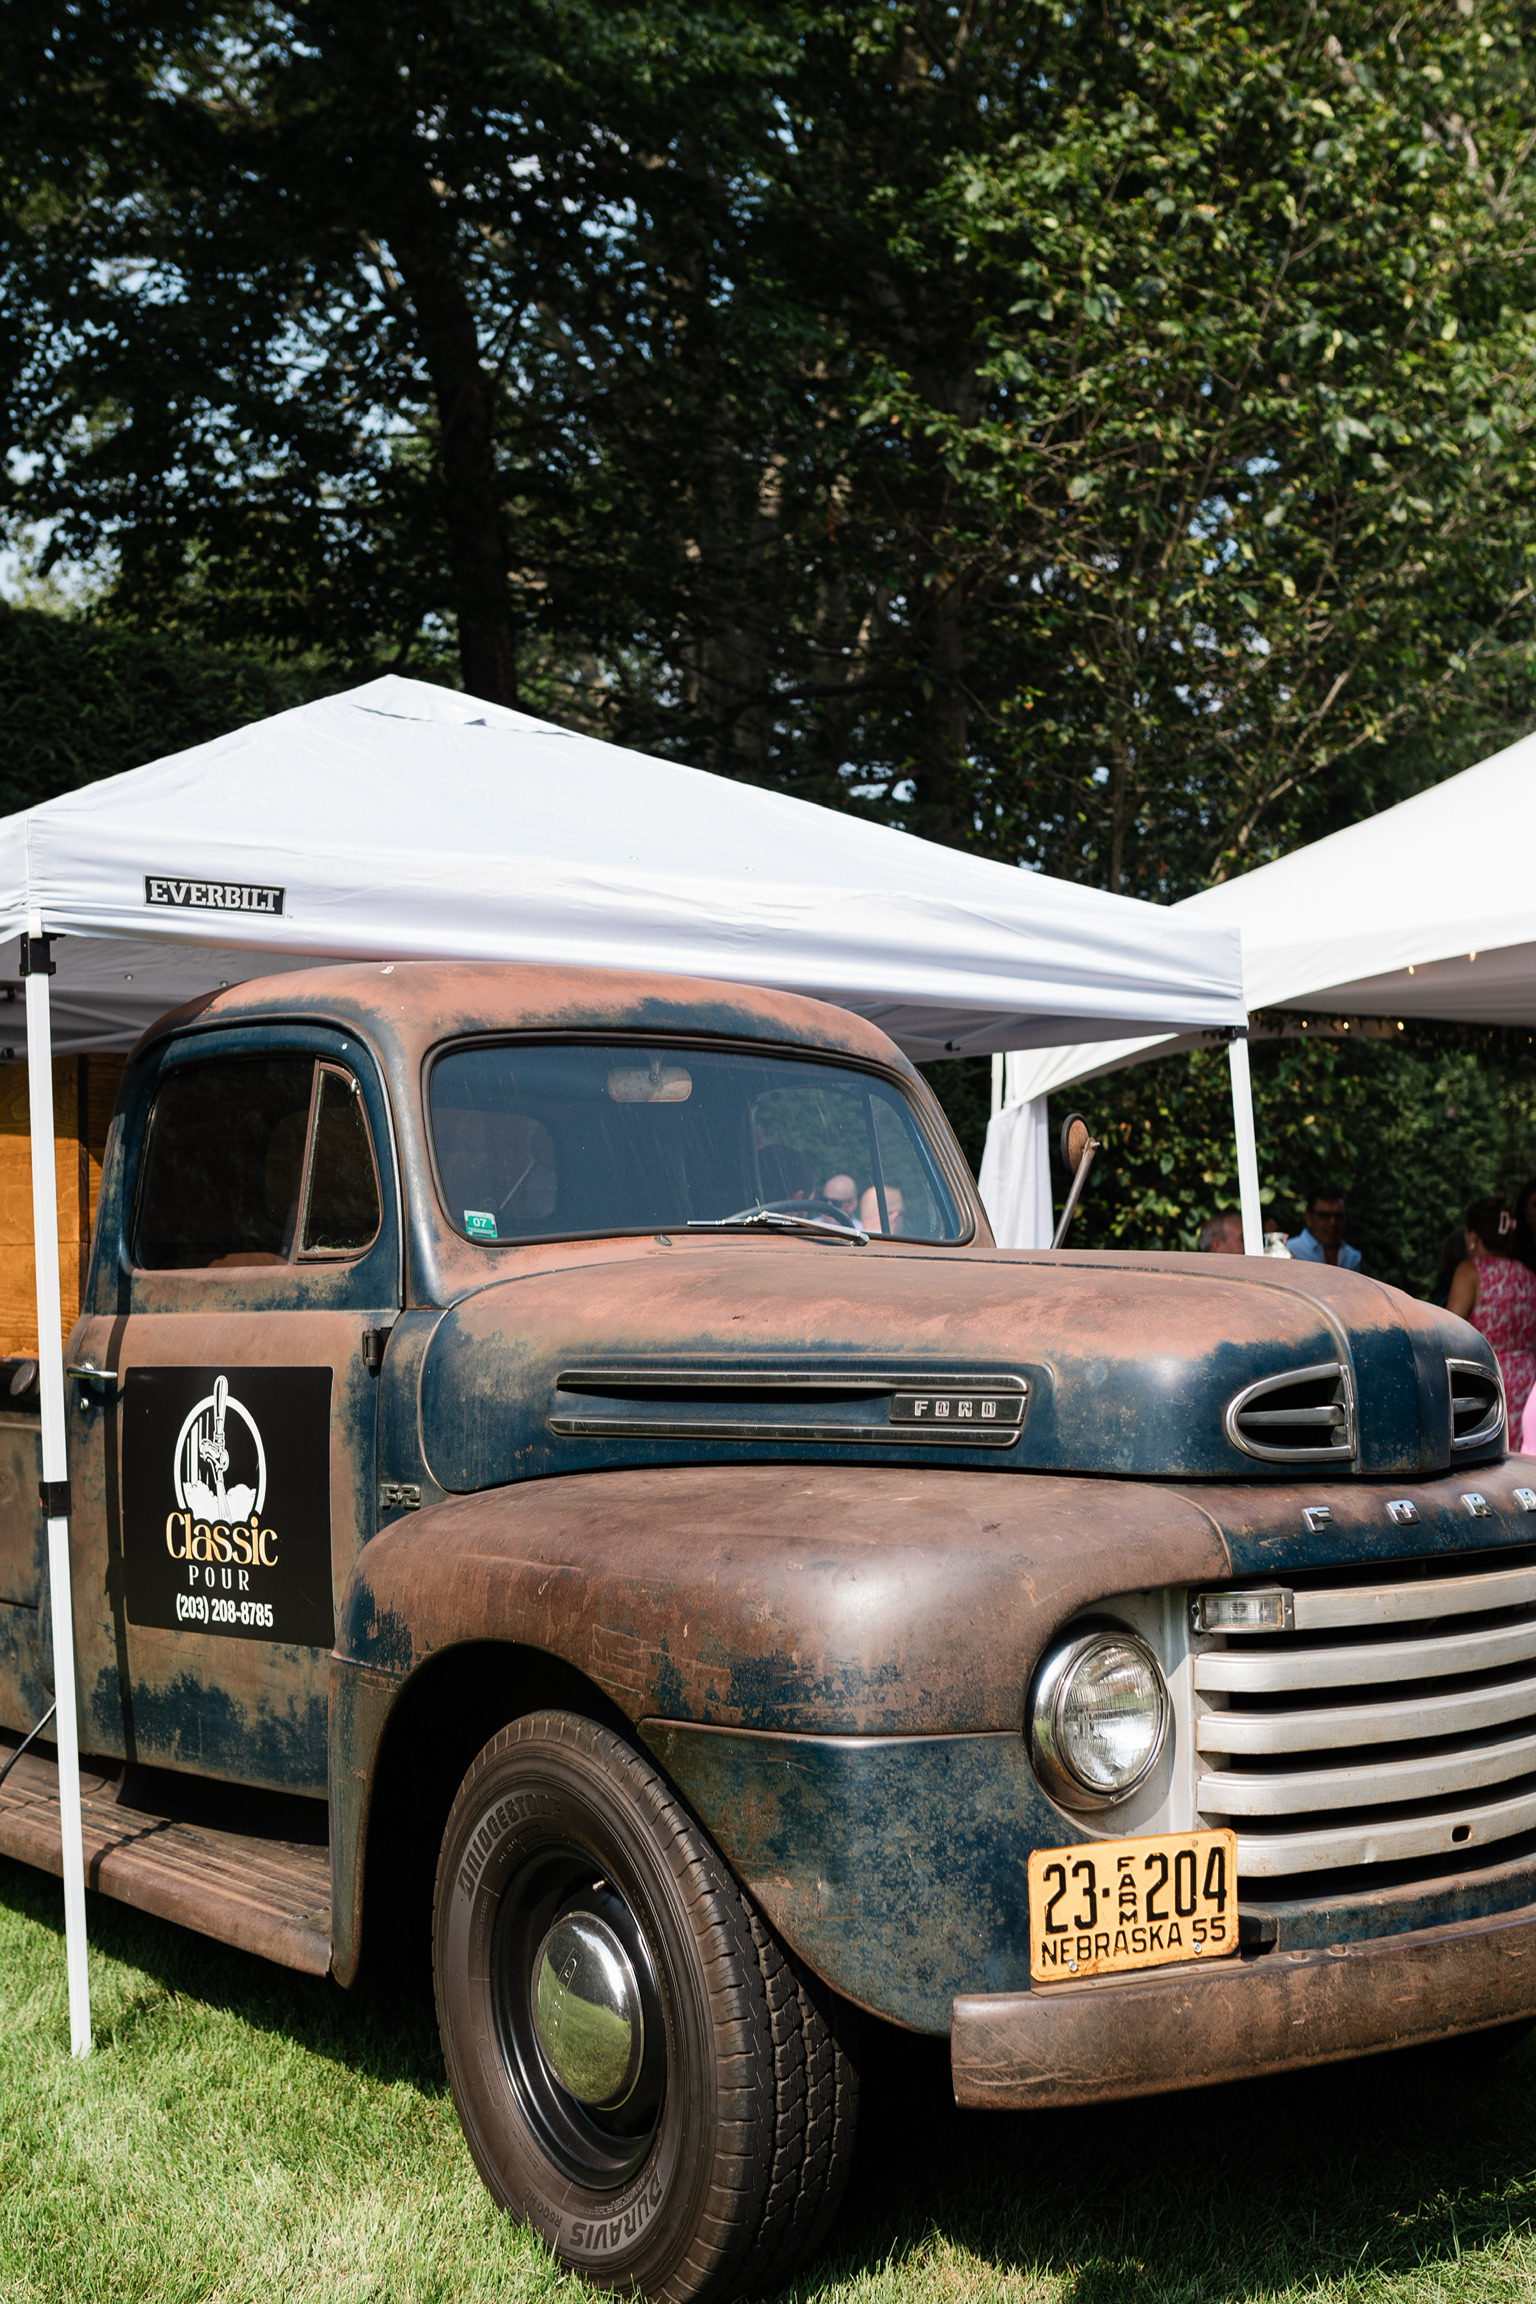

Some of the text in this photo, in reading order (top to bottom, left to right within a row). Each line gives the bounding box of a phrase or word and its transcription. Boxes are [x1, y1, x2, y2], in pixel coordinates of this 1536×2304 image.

[150, 880, 280, 911] EVERBILT
[472, 1217, 487, 1228] 07
[914, 1400, 997, 1418] FORD
[165, 1511, 279, 1567] Classic
[188, 1564, 250, 1591] POUR
[176, 1593, 274, 1627] (203) 208-8785
[1040, 1916, 1226, 1967] NEBRASKA 55
[537, 2205, 563, 2229] R500
[569, 2169, 663, 2250] DURAVIS
